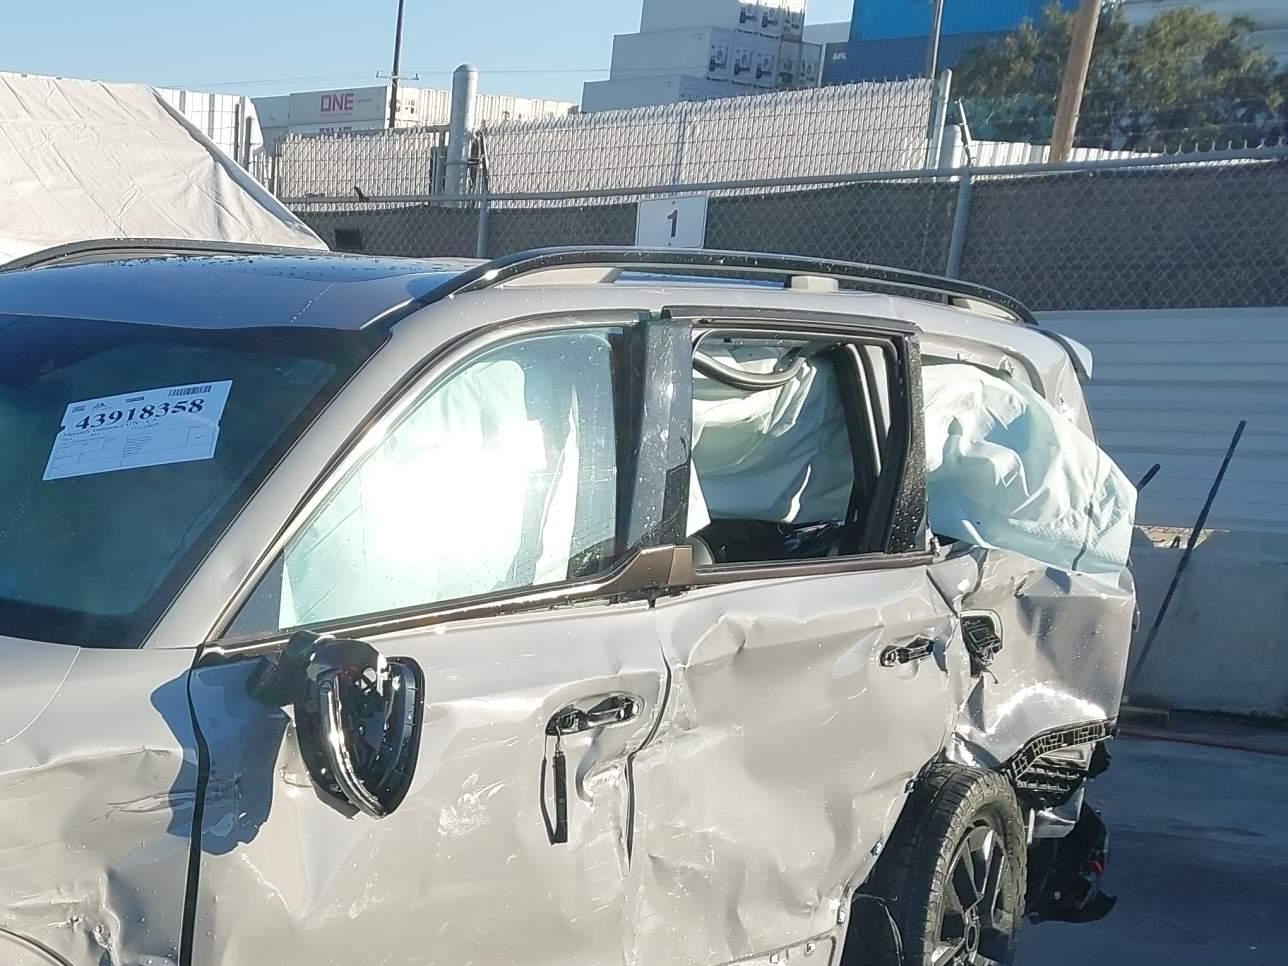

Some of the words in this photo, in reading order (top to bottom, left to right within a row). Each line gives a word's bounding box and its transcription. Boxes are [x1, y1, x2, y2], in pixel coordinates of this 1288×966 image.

[320, 93, 354, 112] ONE
[667, 209, 678, 238] 1
[75, 398, 205, 430] 43918358
